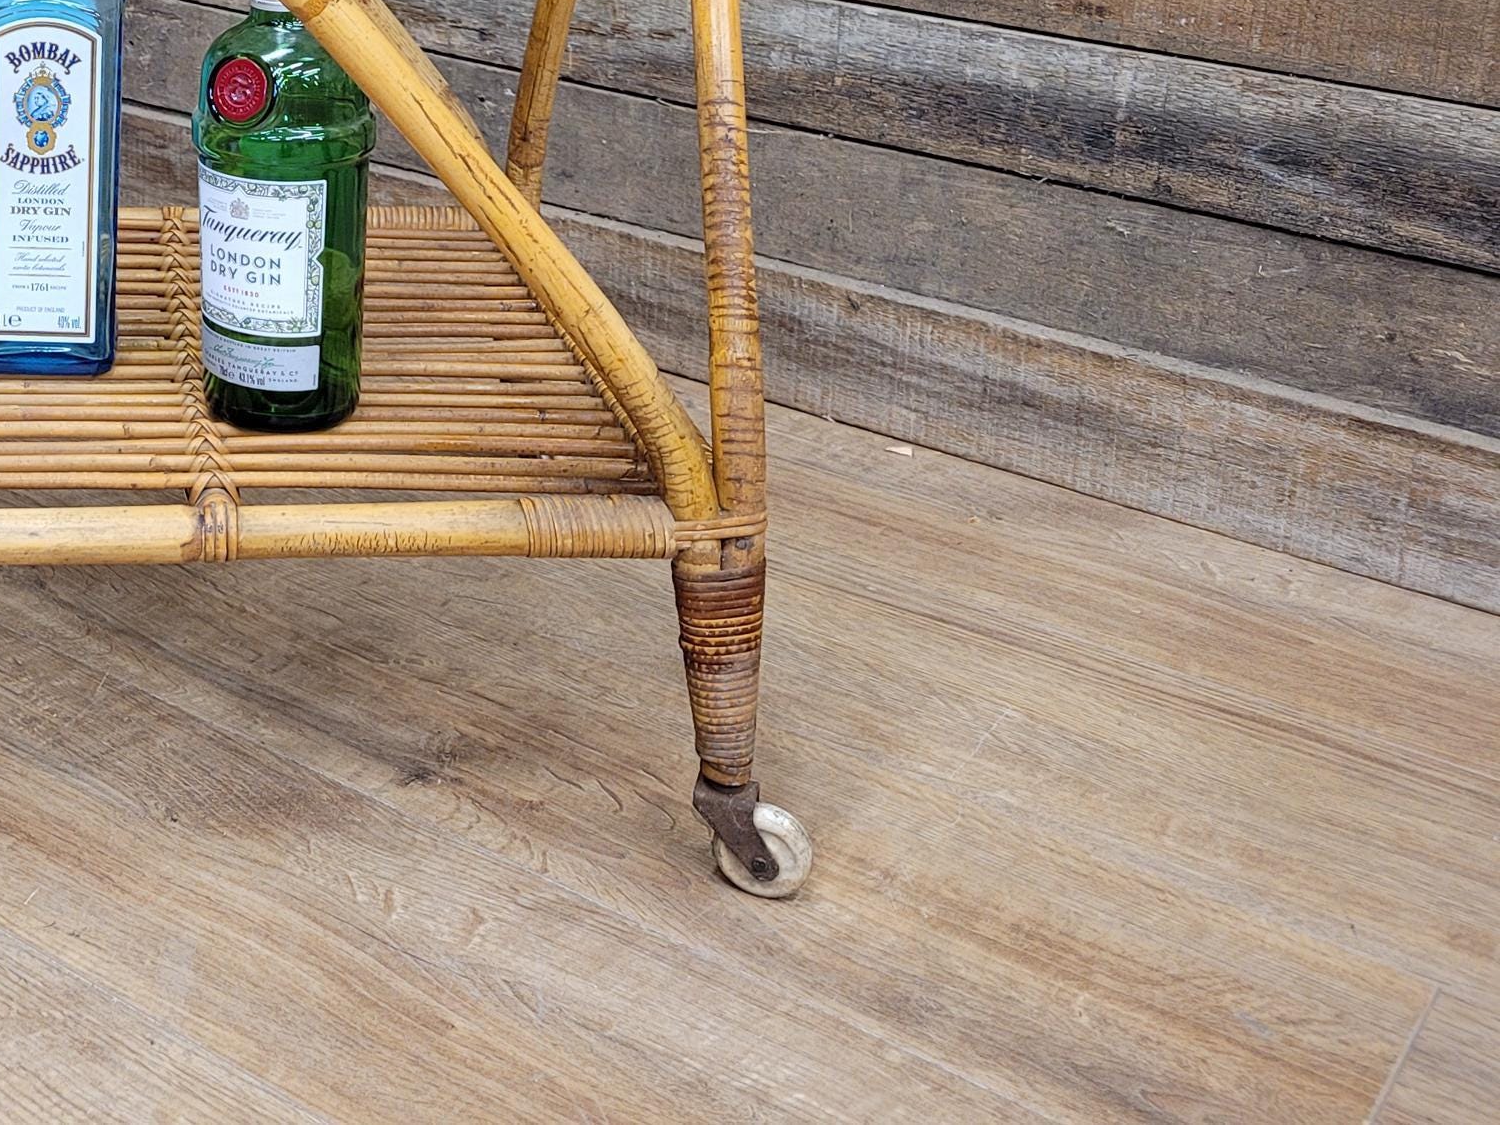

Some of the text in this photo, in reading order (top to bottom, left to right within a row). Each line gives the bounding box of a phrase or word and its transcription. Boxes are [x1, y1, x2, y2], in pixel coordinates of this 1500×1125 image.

[4, 41, 82, 75] BOMBAY
[0, 142, 81, 175] SAPPHIRE
[11, 179, 71, 196] Distilled
[18, 197, 65, 205] LONDON
[10, 206, 71, 216] DRY GIN
[19, 218, 61, 234] Vapour
[202, 204, 302, 251] Tanqueray
[12, 235, 69, 243] INFUSED
[210, 243, 281, 269] LONDON
[211, 259, 281, 285] DRY GIN
[30, 282, 49, 292] 1761
